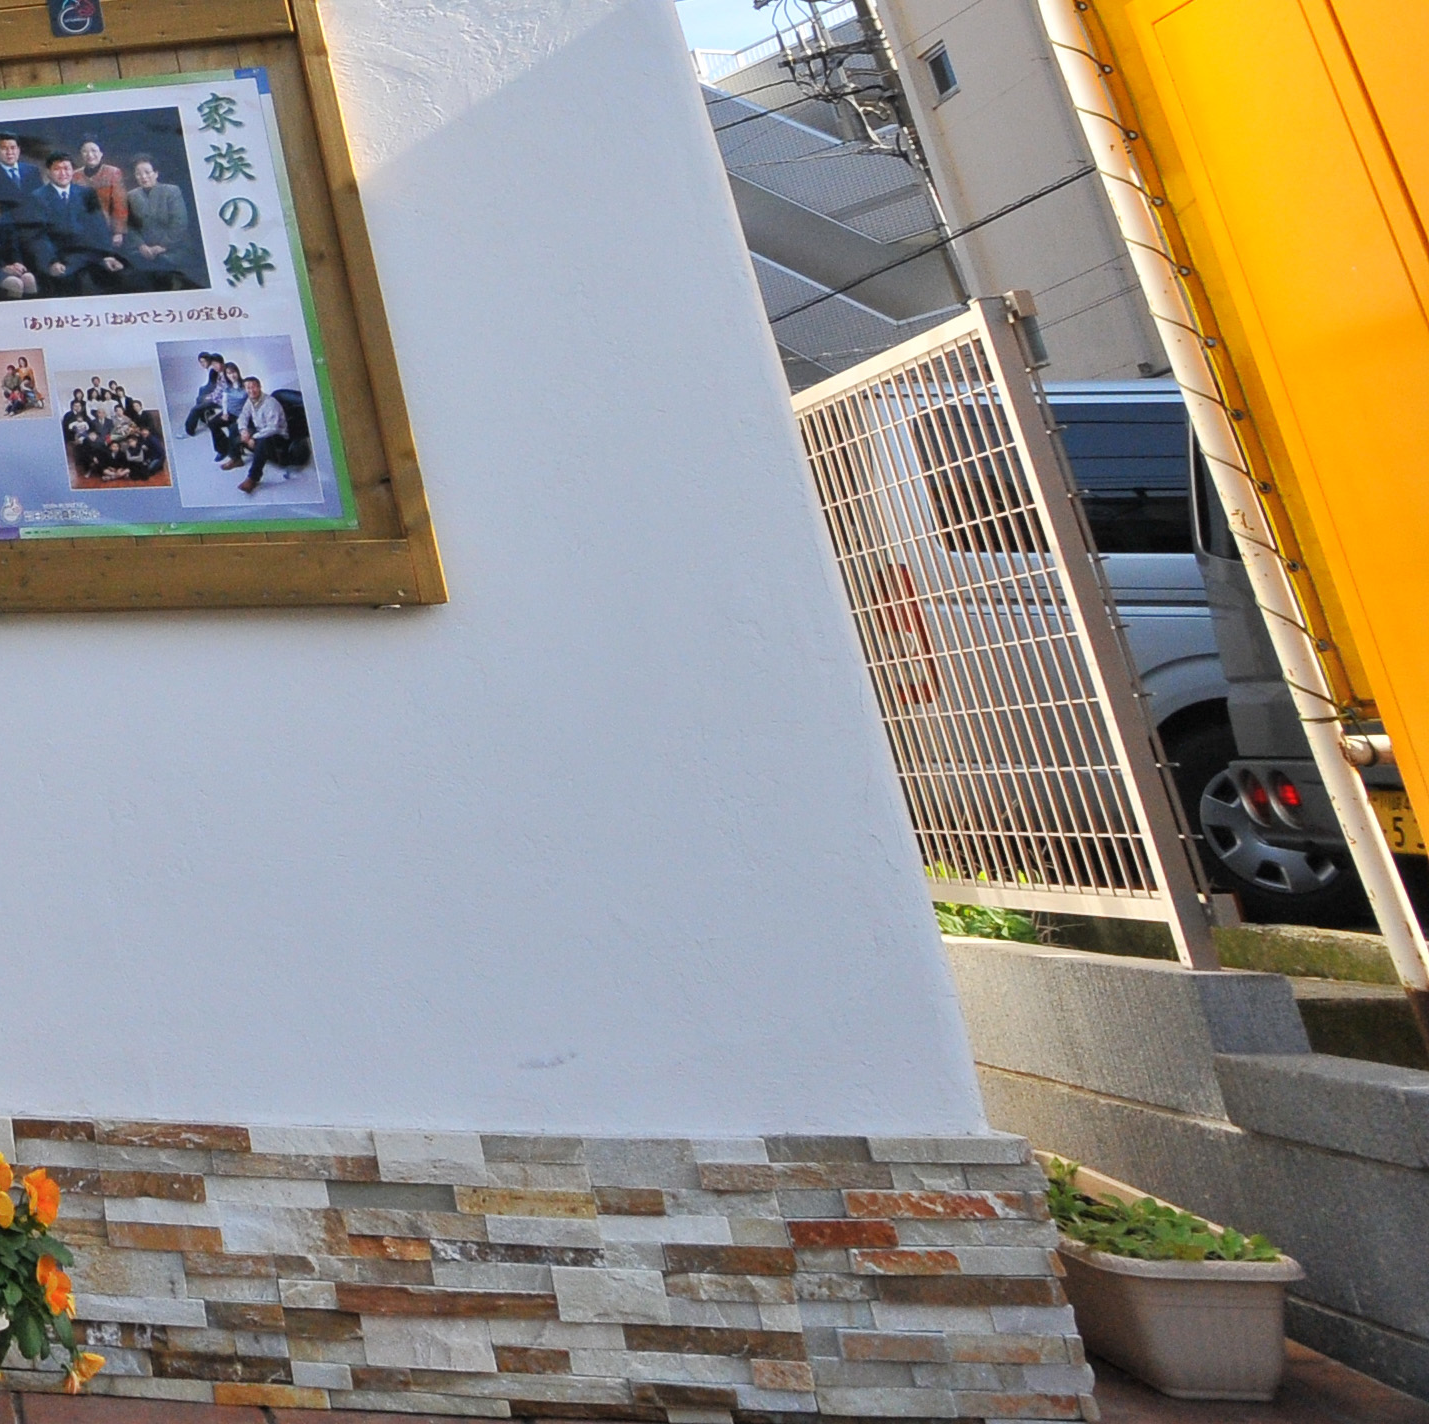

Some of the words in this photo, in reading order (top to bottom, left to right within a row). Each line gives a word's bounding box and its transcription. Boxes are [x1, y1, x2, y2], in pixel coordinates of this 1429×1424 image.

[197, 92, 277, 288] 家族の絆
[23, 305, 250, 331] 「ありがとう」「おめでとう」の宝もの。
